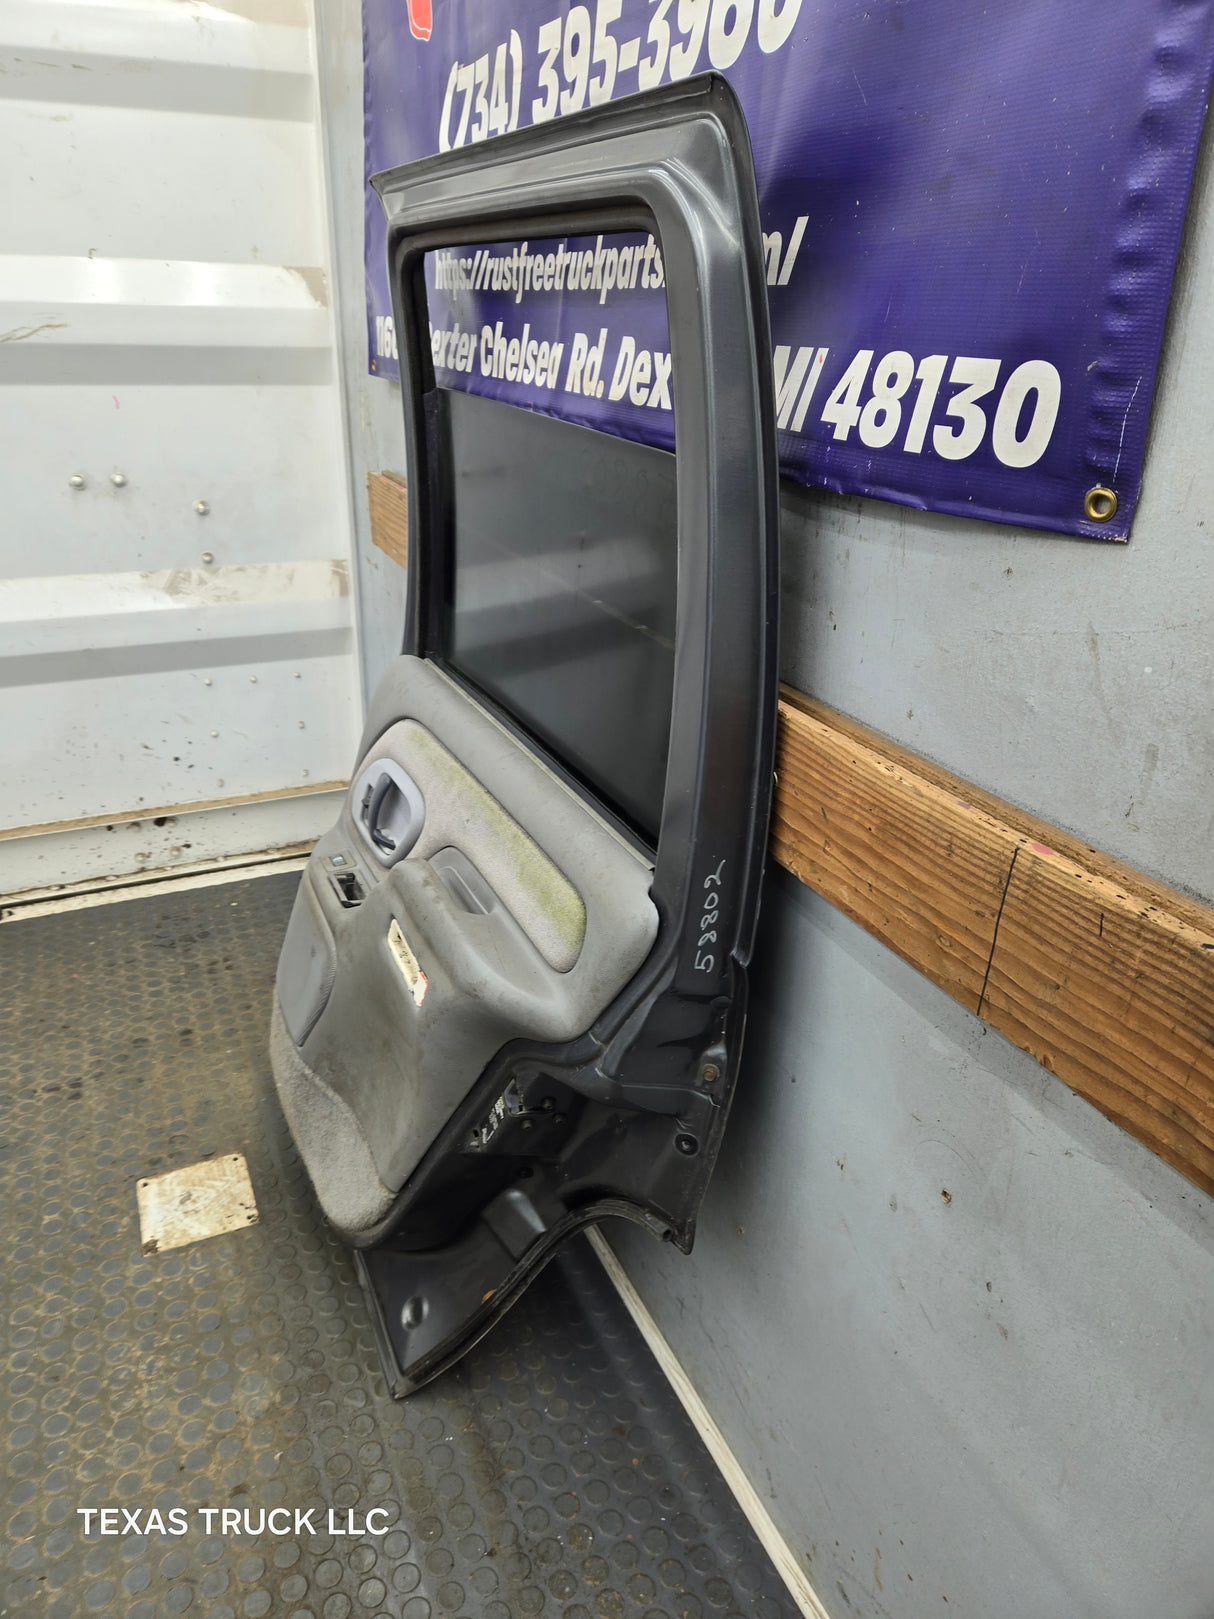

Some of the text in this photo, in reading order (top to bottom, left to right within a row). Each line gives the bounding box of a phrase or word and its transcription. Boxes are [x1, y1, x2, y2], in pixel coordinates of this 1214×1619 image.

[439, 28, 523, 153] (734)
[429, 321, 477, 373] exter
[480, 321, 565, 388] Chelsea
[565, 328, 608, 399] Rd.
[773, 345, 829, 432] MI
[820, 350, 1061, 468] 48130
[694, 859, 726, 973] 58802
